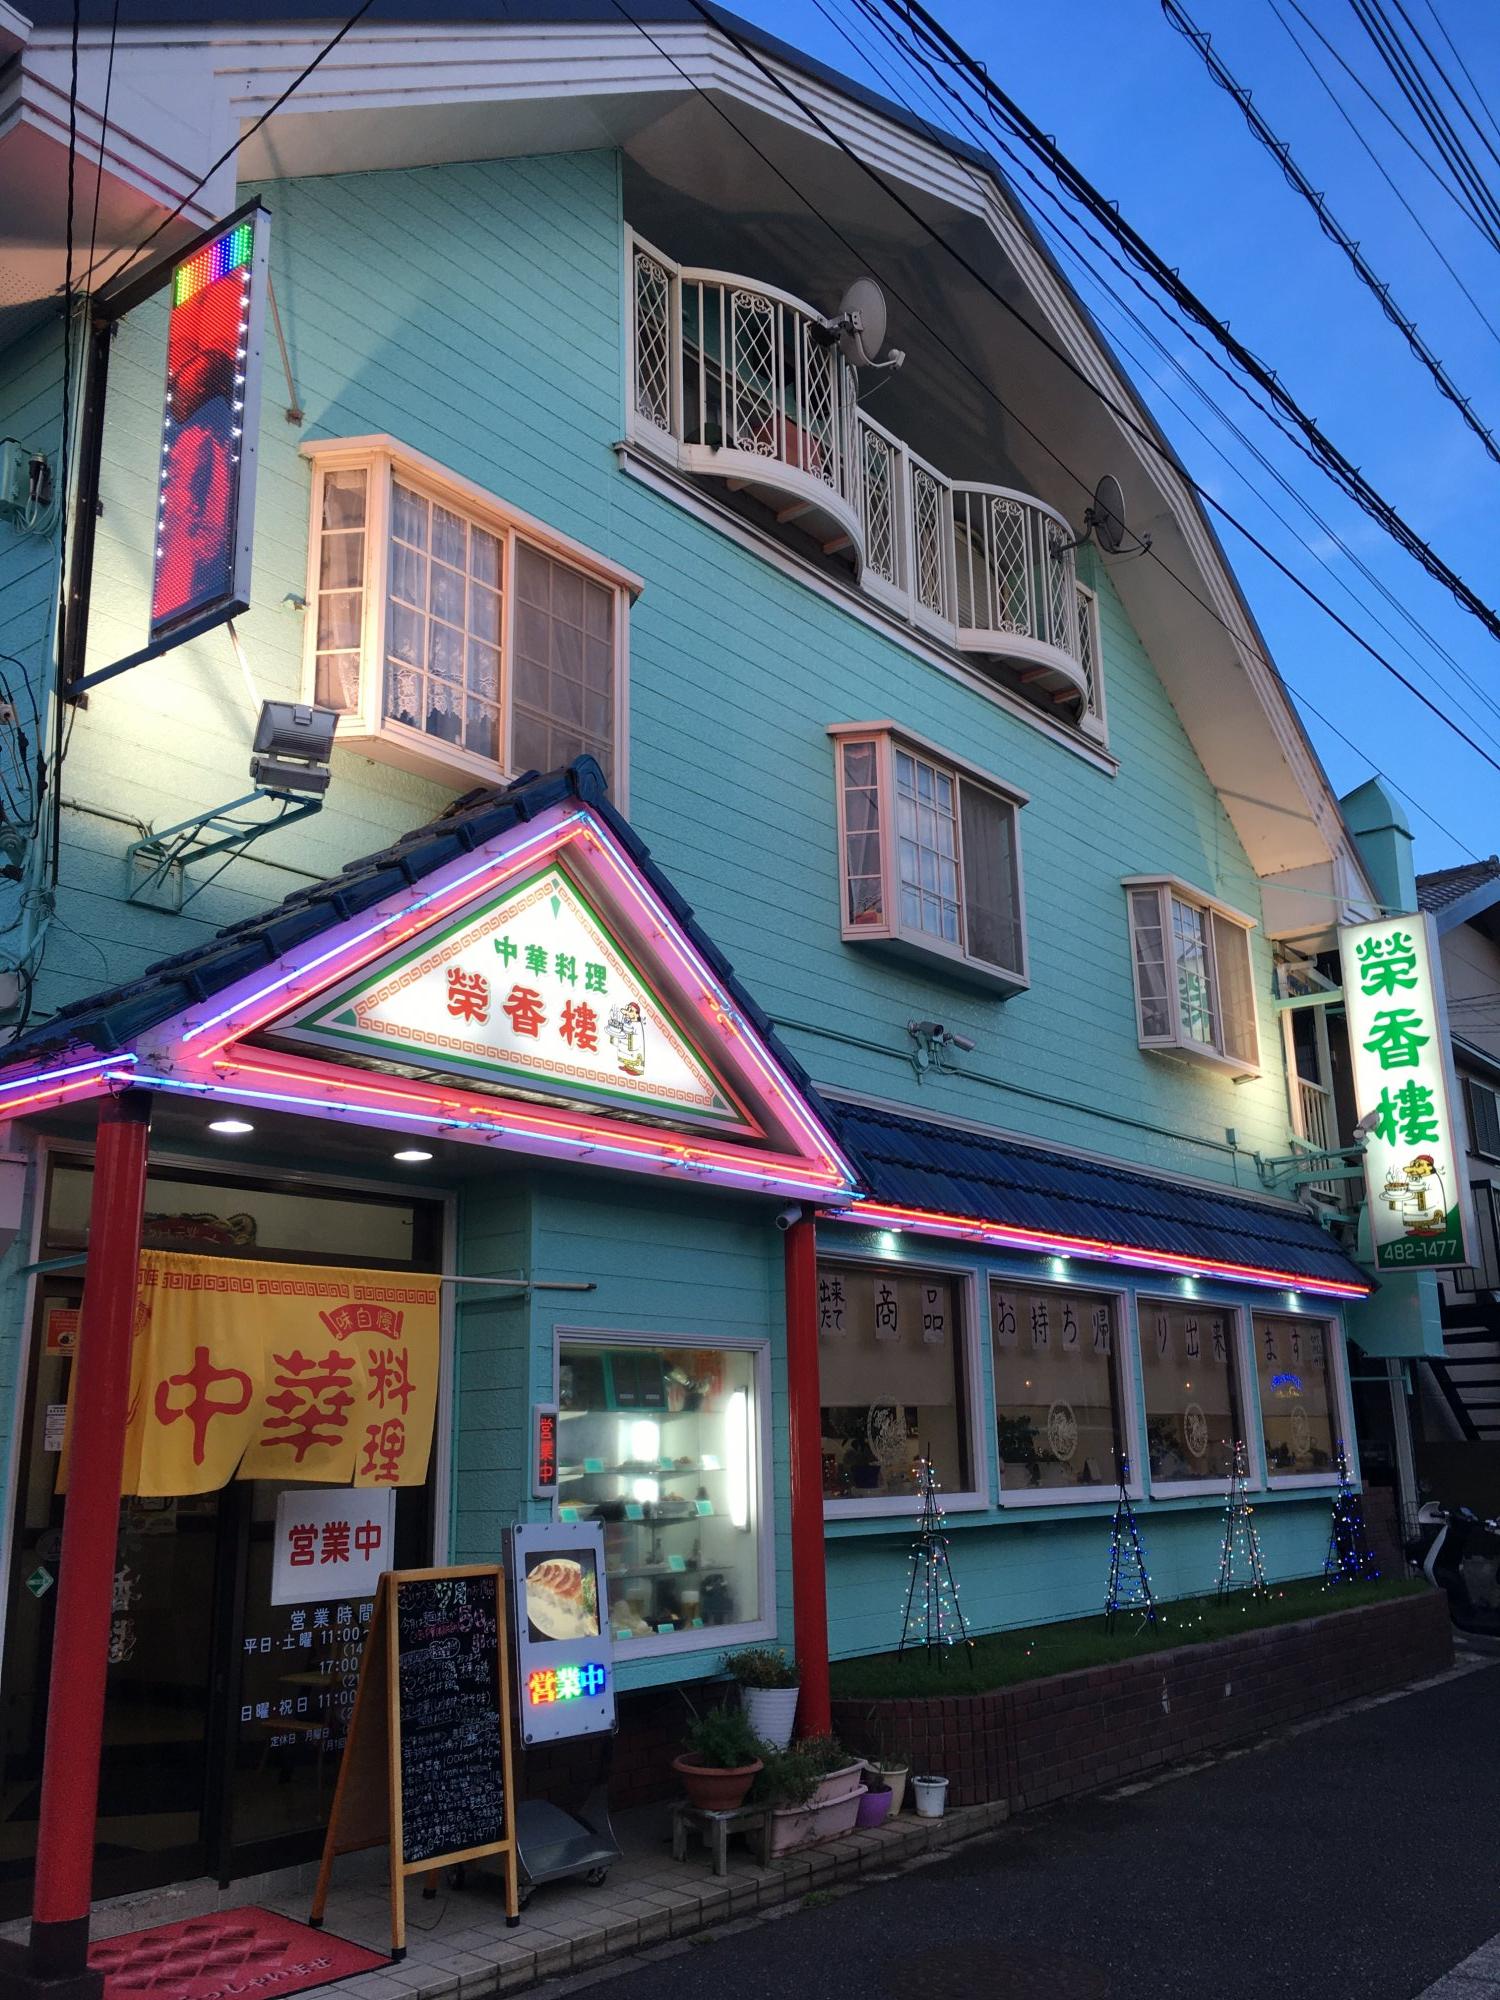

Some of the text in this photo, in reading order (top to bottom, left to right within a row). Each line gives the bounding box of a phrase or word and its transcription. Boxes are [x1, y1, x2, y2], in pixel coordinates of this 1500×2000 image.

[494, 936, 609, 995] 中華料理
[446, 968, 599, 1053] 榮香樓
[1355, 931, 1440, 1147] 榮香樓
[1384, 1239, 1457, 1261] 482-1477
[335, 1305, 394, 1336] 味自慢
[288, 1519, 382, 1567] 営業中
[290, 1603, 374, 1631] 営業時間
[243, 1631, 313, 1655] 平日・土曜
[529, 1662, 605, 1708] 営業中
[241, 1696, 309, 1722] 日曜・祝日
